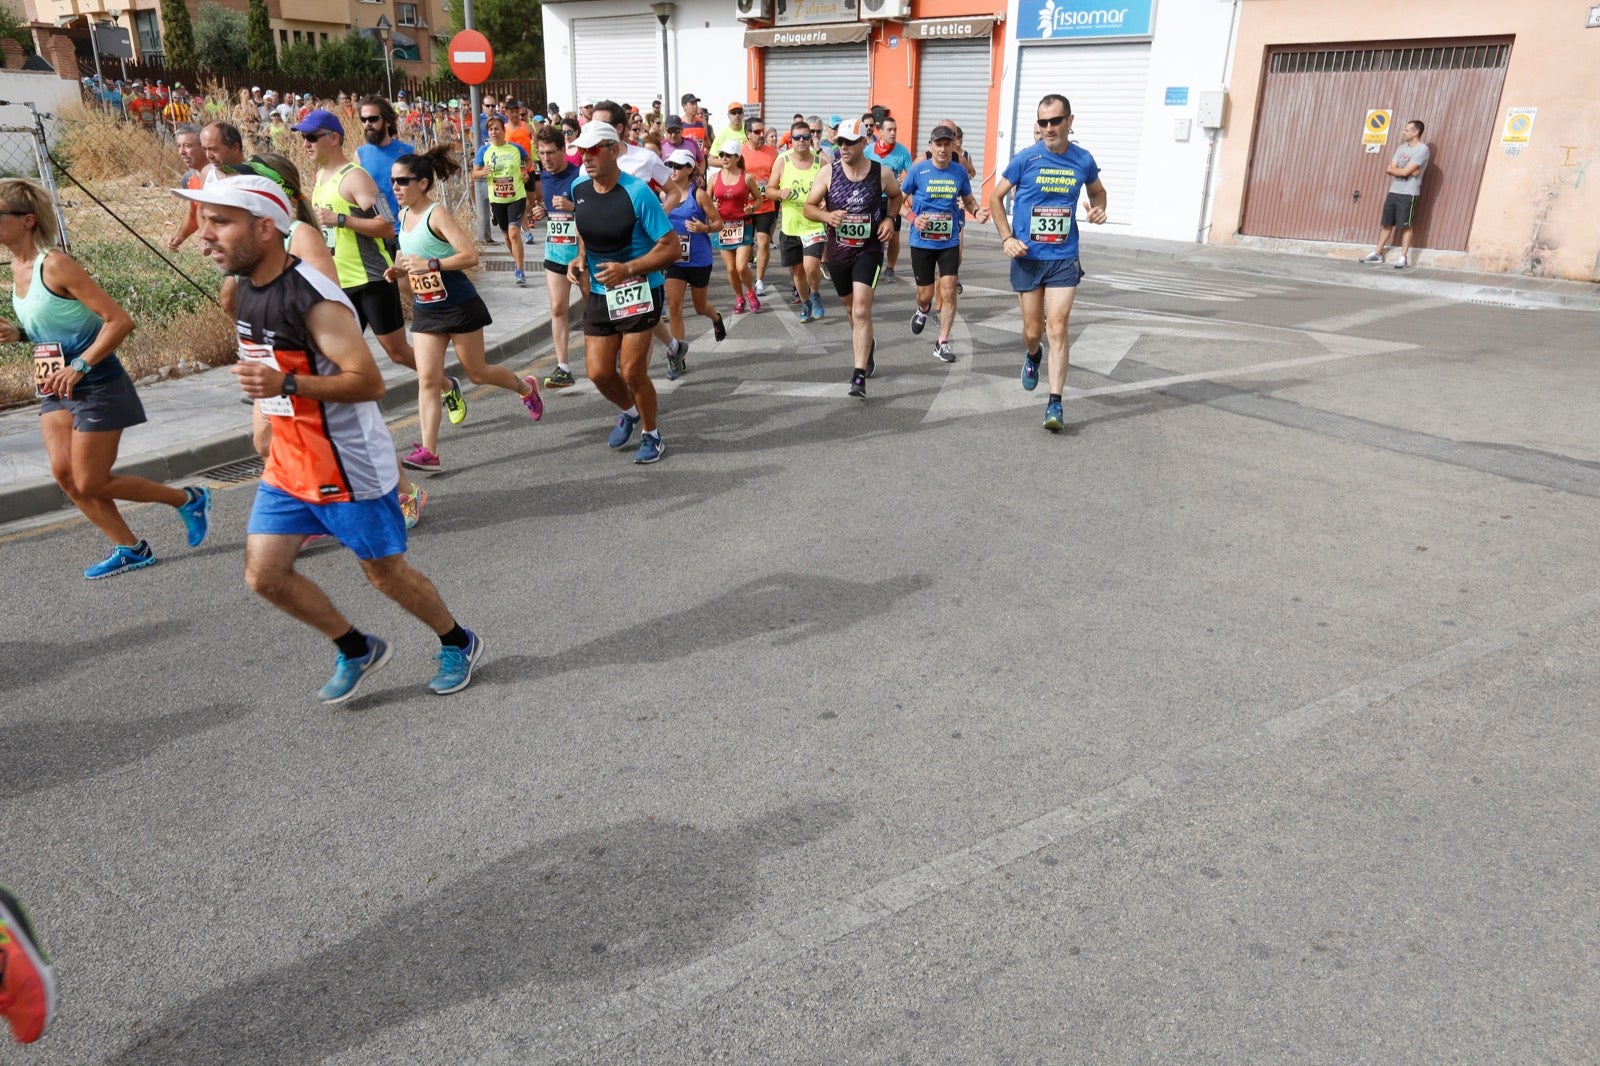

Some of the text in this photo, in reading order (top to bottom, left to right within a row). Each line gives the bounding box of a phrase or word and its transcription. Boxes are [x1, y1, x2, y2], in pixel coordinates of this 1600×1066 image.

[1053, 6, 1129, 30] fisiomar
[920, 23, 972, 36] Estetica
[774, 31, 827, 43] Peluqueria
[495, 183, 514, 191] 2072
[1036, 175, 1077, 186] RUISEÑOR
[550, 222, 570, 234] 997
[840, 224, 866, 237] 430
[927, 221, 948, 232] 323
[1038, 218, 1064, 232] 331
[411, 274, 440, 290] 2163
[615, 285, 643, 306] 657
